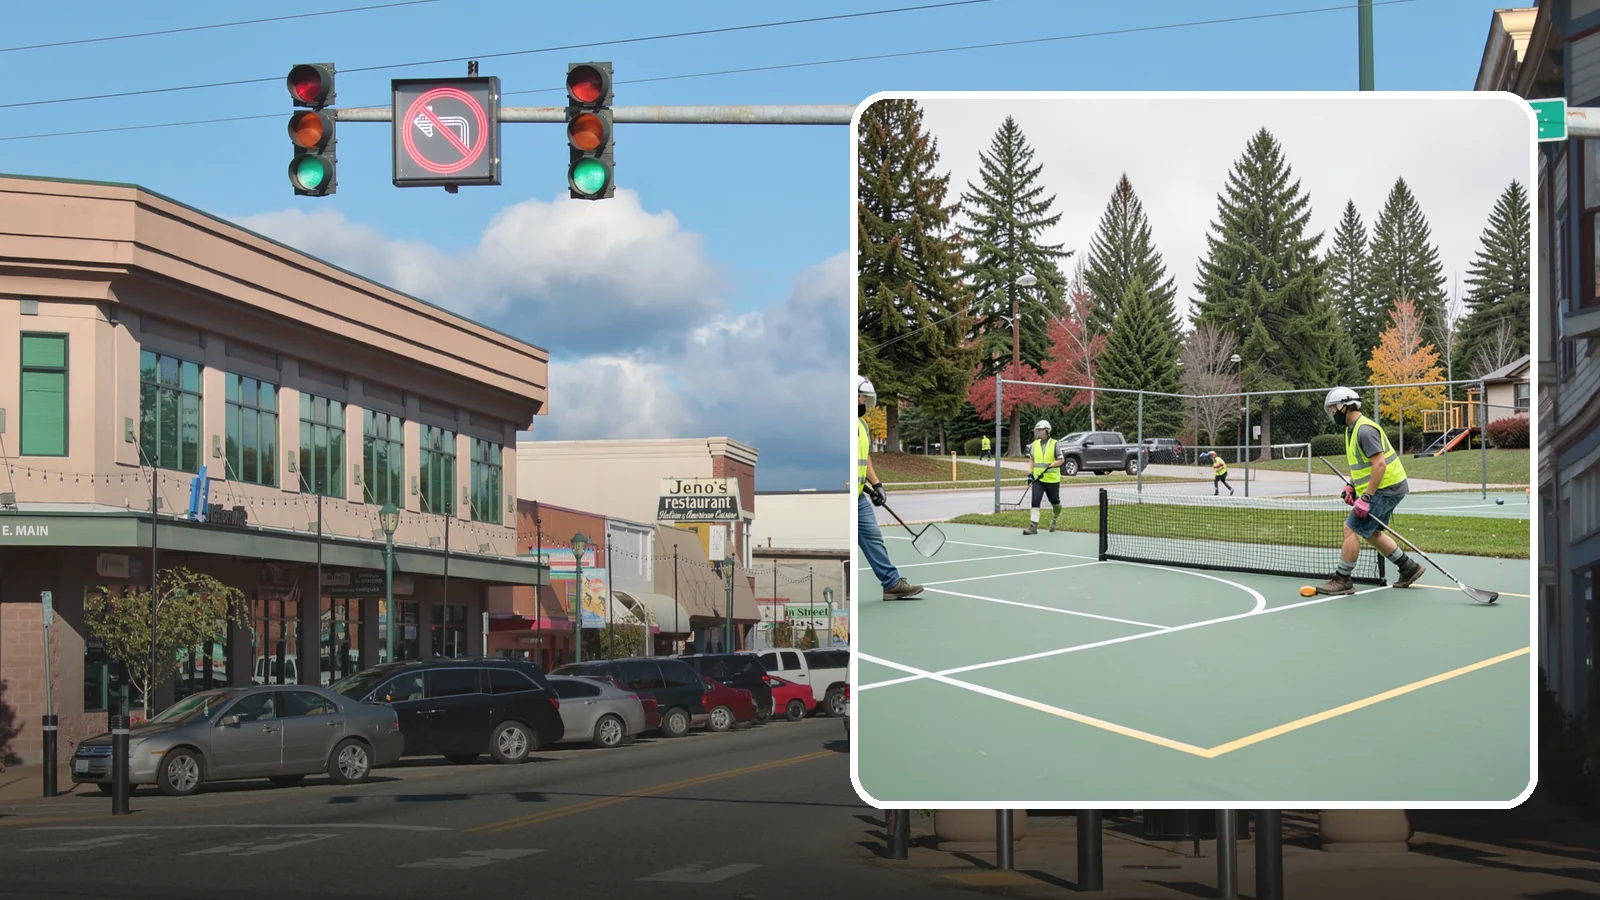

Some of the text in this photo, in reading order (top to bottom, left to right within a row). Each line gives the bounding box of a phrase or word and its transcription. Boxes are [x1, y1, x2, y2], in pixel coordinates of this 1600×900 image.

[670, 480, 727, 494] Jeno's
[665, 496, 730, 508] restaurant
[686, 509, 714, 519] American
[715, 509, 737, 519] Cuisine
[2, 525, 49, 536] E. MAIN
[797, 607, 829, 617] Street
